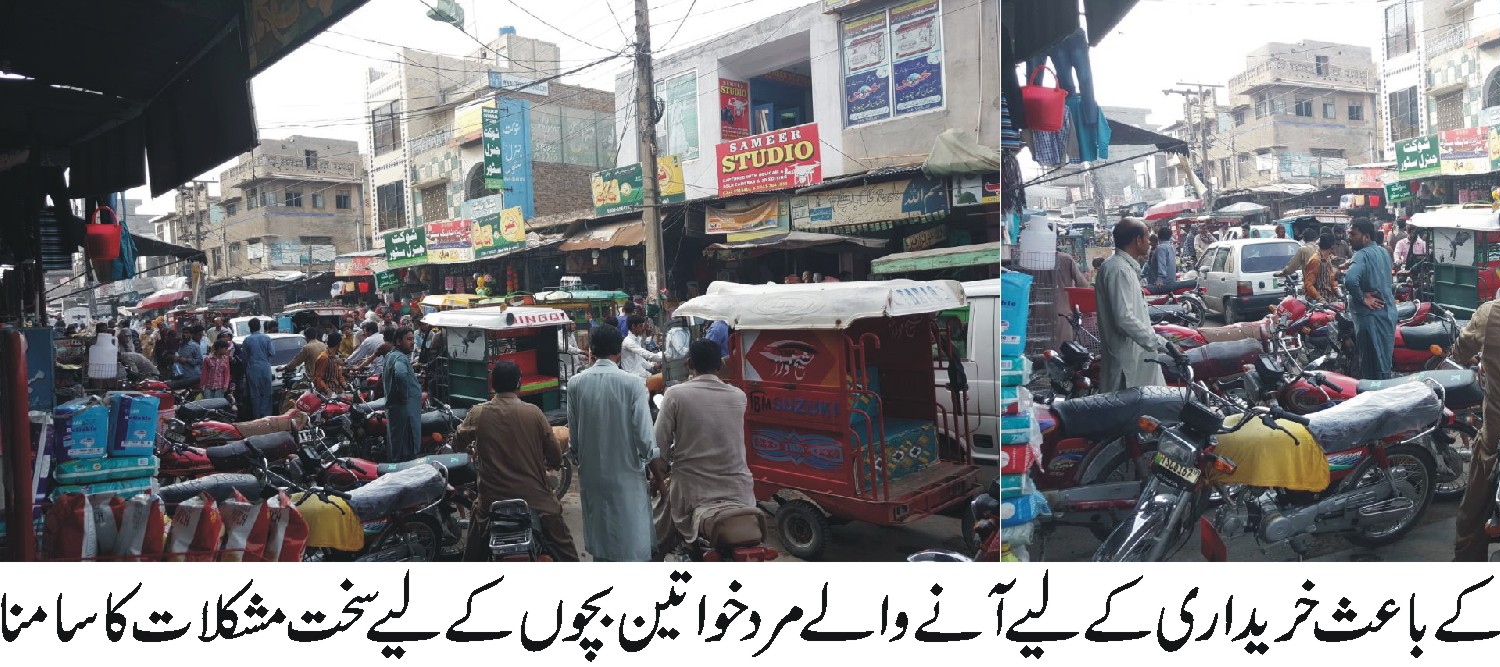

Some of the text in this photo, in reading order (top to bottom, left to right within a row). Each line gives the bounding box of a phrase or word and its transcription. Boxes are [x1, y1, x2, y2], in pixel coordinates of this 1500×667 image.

[720, 86, 748, 98] STUDIO
[484, 127, 500, 141] شوکت
[729, 130, 801, 153] SAMEER
[485, 143, 501, 157] جنرل
[1403, 137, 1431, 152] شوکت
[721, 140, 814, 174] STUDIO
[1400, 156, 1418, 172] سٹور
[1418, 153, 1439, 170] جنرل
[486, 162, 502, 176] سٹور
[392, 228, 418, 244] شوکت
[389, 246, 406, 261] سٹور
[407, 243, 426, 258] جنرل
[512, 312, 565, 324] INGQI
[774, 397, 840, 417] SUZUKI
